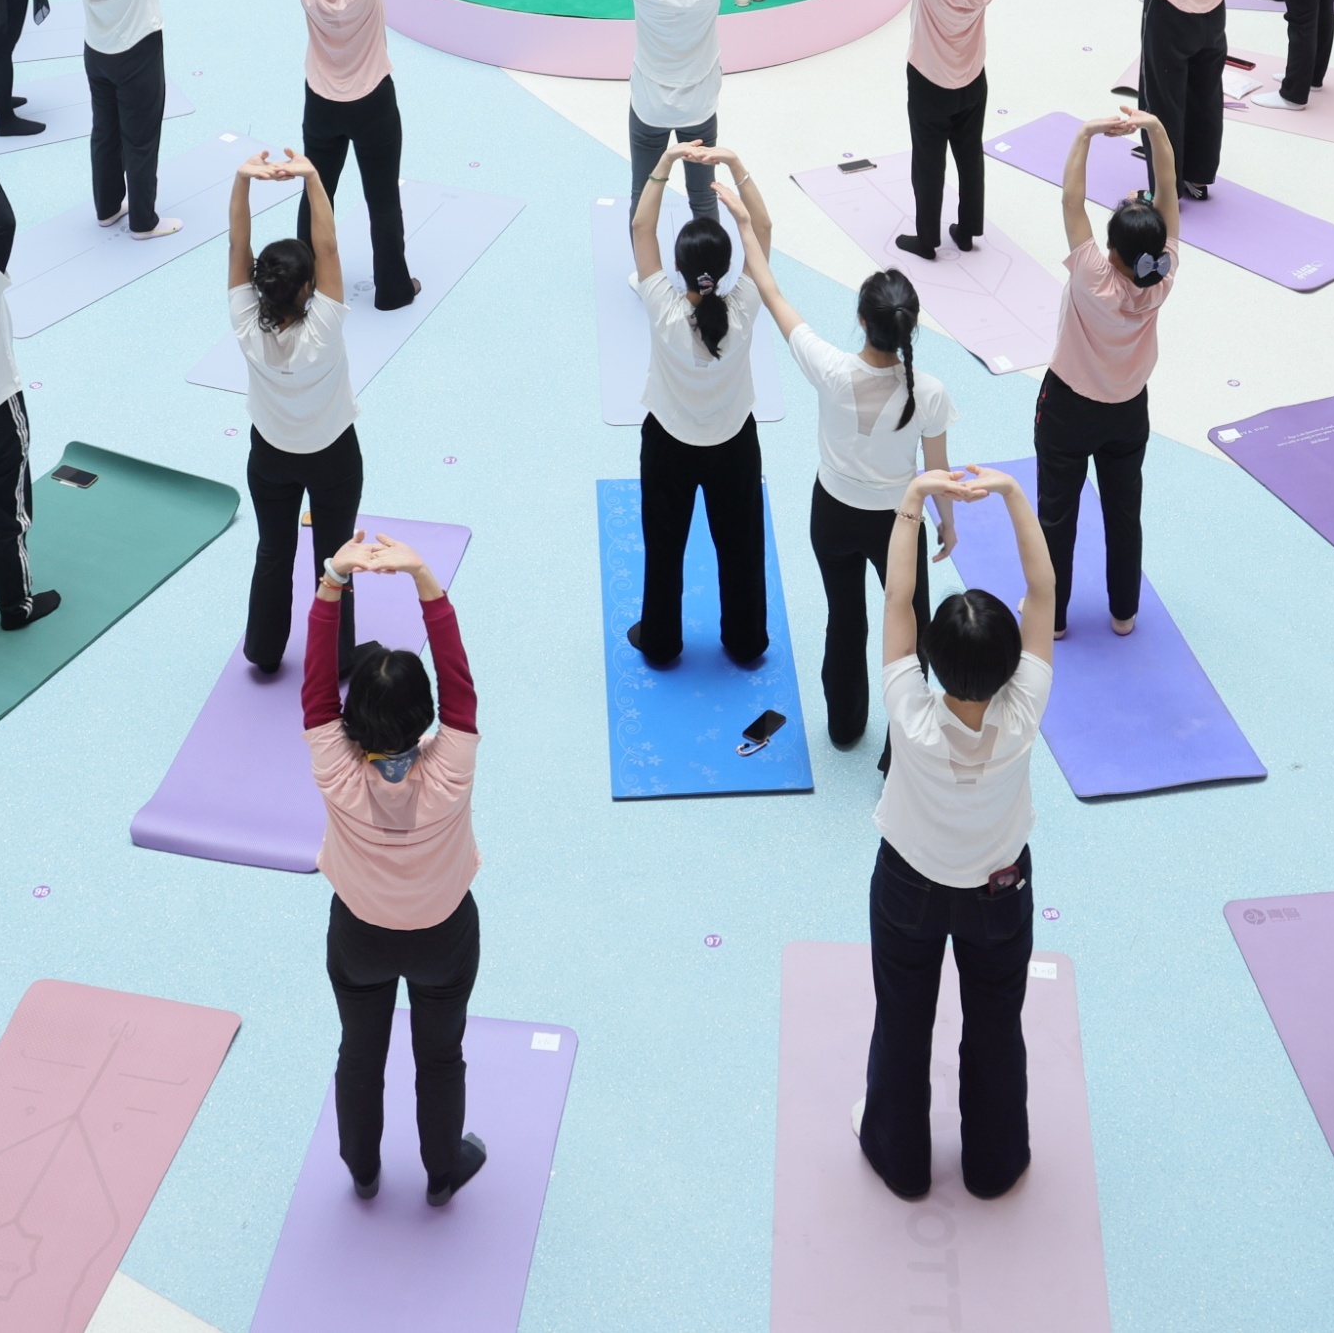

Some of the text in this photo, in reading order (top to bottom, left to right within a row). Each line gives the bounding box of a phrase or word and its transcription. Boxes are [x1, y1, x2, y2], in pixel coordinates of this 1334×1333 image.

[34, 887, 49, 896] 95
[1043, 909, 1058, 919] 98
[706, 936, 721, 946] 97
